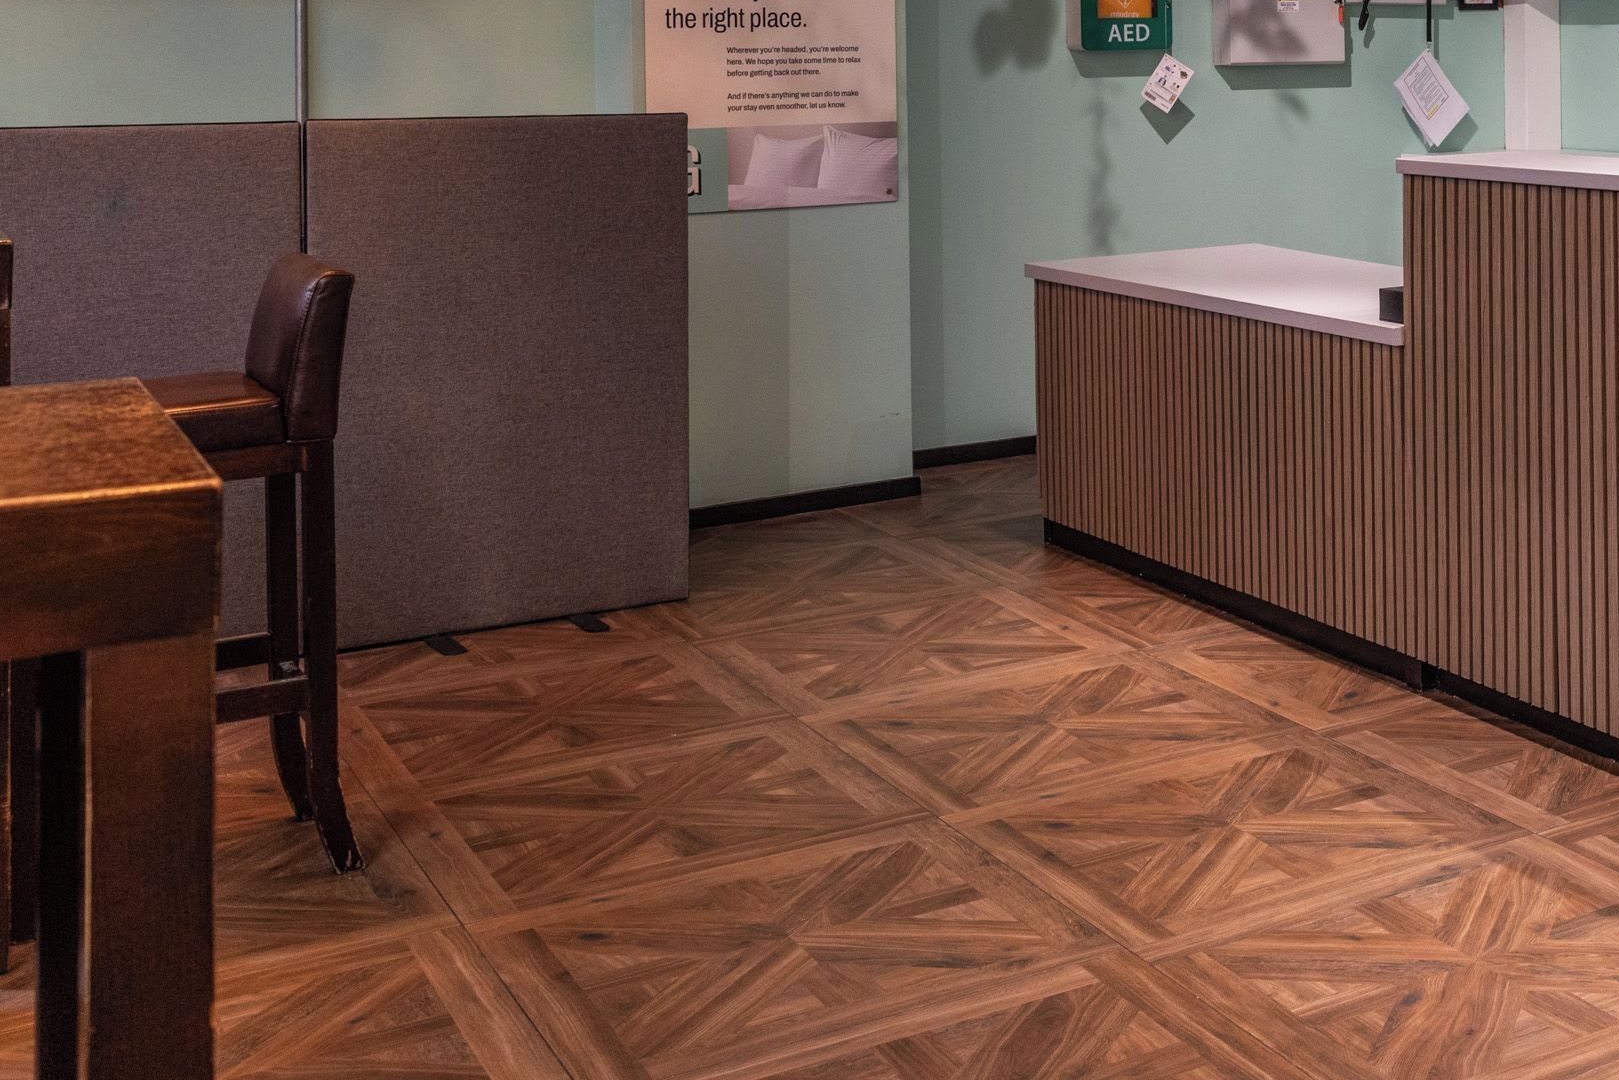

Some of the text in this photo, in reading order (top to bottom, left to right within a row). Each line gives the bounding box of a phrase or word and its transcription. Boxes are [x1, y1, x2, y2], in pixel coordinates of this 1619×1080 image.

[665, 7, 807, 33] the right place.
[1108, 23, 1150, 42] AED
[781, 46, 808, 54] headed,
[757, 58, 774, 66] hope
[727, 69, 749, 77] before
[749, 69, 773, 78] getting
[774, 68, 790, 76] back
[771, 91, 799, 100] anything
[727, 105, 742, 113] your
[743, 104, 758, 112] stay
[775, 102, 808, 111] smoother,
